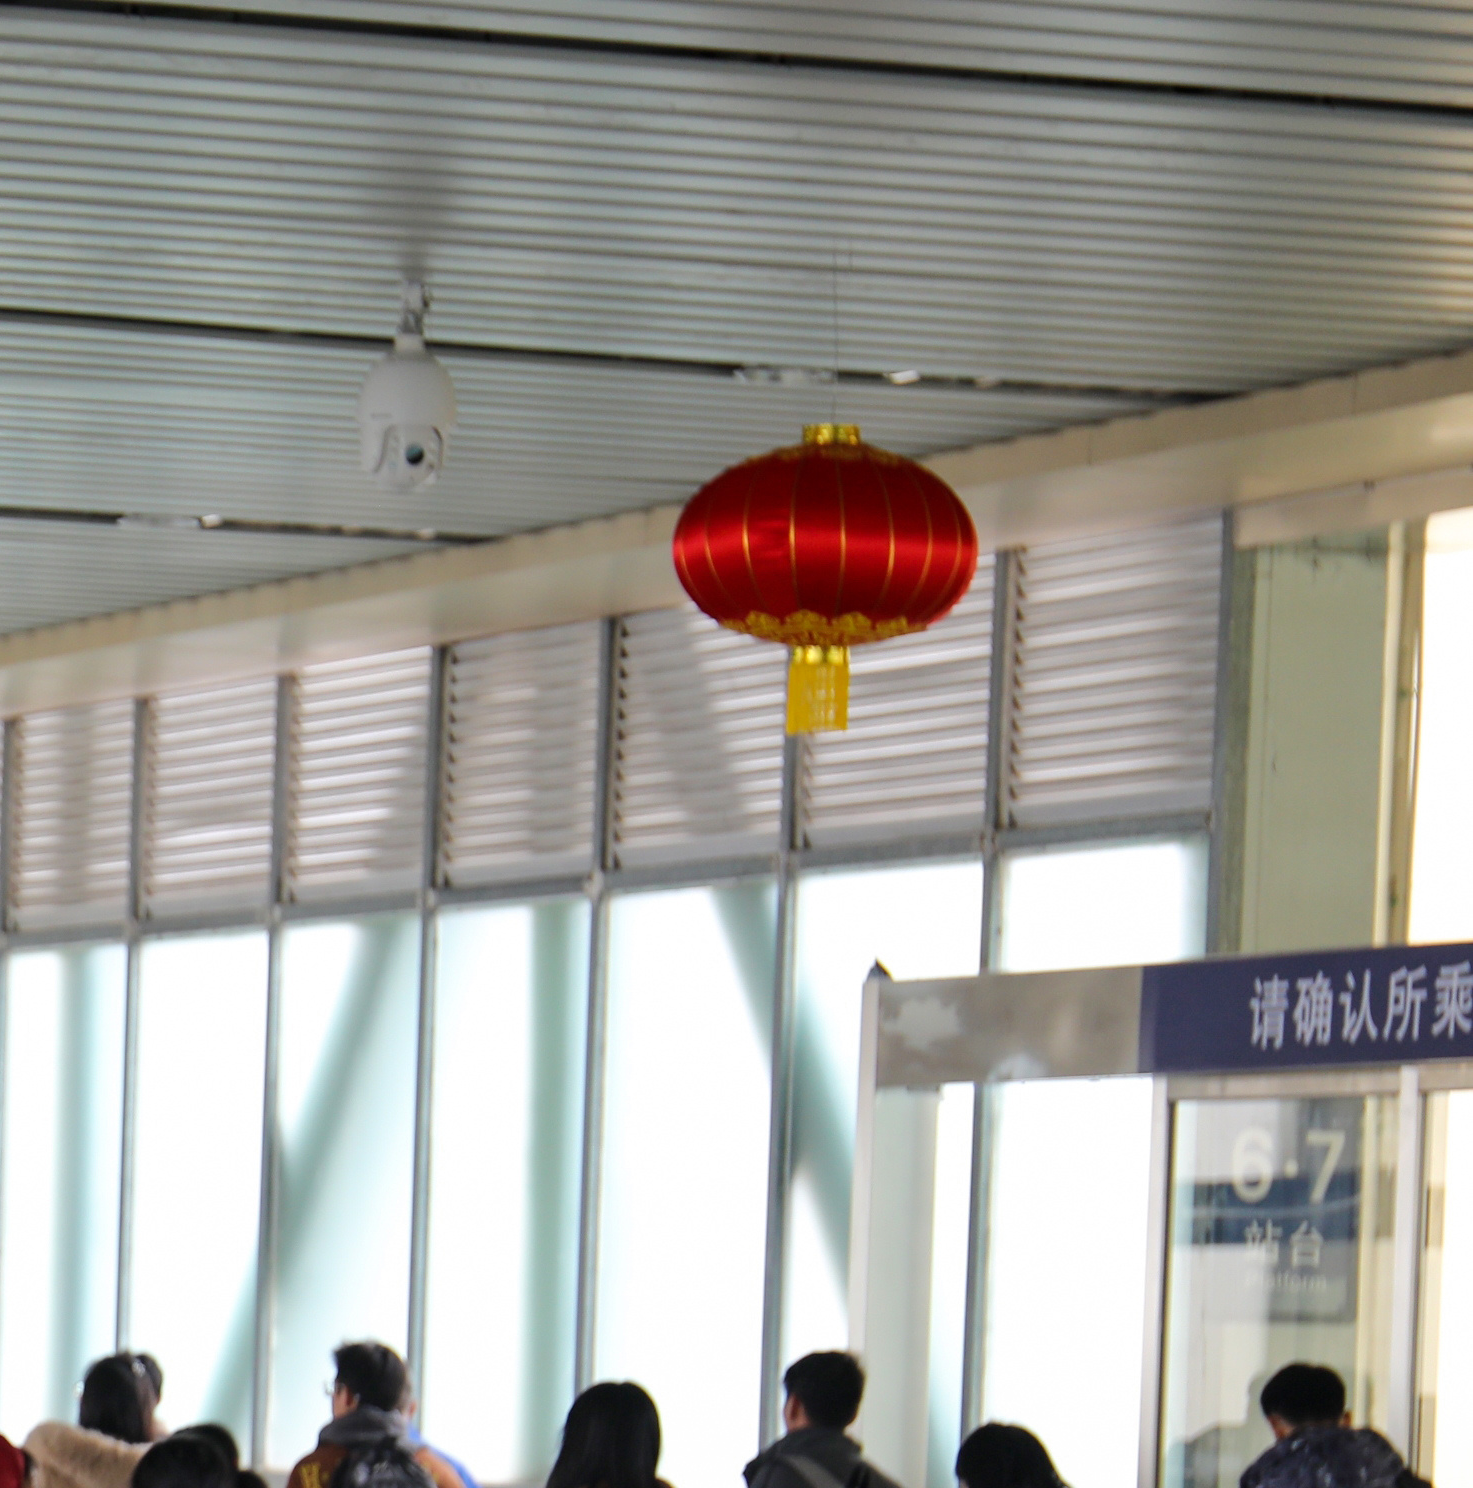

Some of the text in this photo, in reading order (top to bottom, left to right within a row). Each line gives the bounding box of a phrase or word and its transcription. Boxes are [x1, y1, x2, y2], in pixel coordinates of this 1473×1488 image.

[1250, 960, 1473, 1050] 请确认所乘
